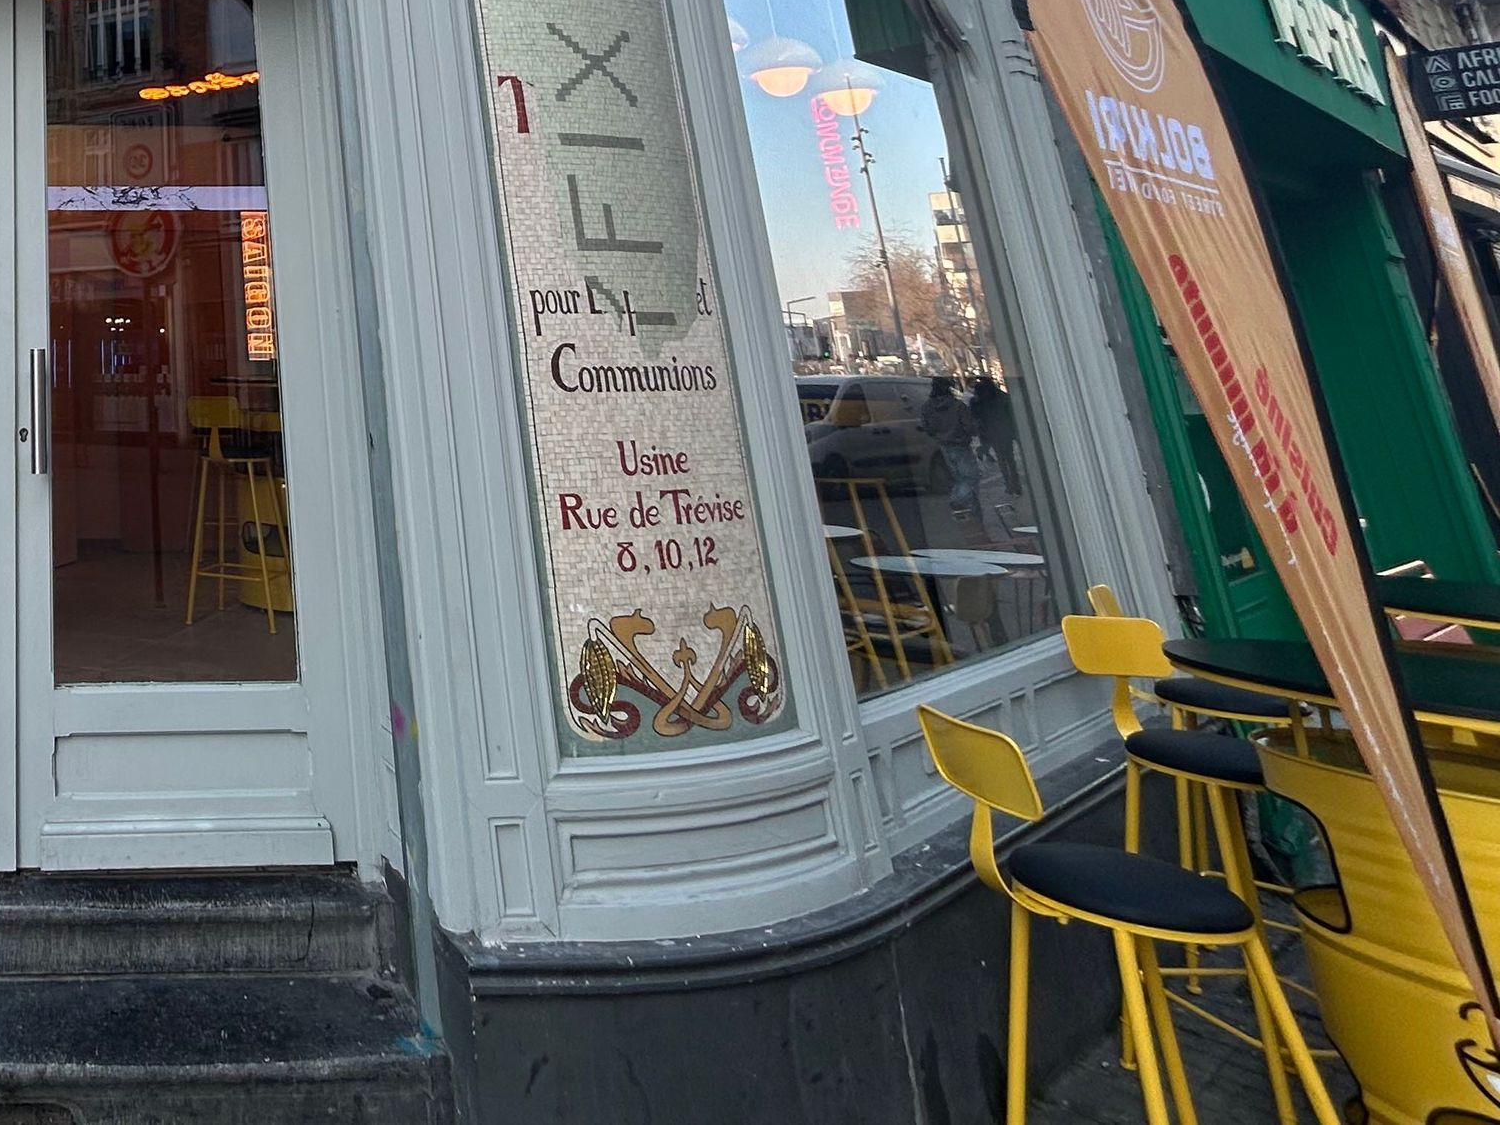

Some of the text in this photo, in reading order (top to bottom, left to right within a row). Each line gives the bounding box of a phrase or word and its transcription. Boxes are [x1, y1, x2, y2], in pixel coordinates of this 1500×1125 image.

[529, 288, 581, 337] pour
[550, 342, 718, 394] Communions
[616, 440, 691, 477] Usine
[559, 488, 746, 531] Rue de Trévise
[695, 536, 720, 569] 12
